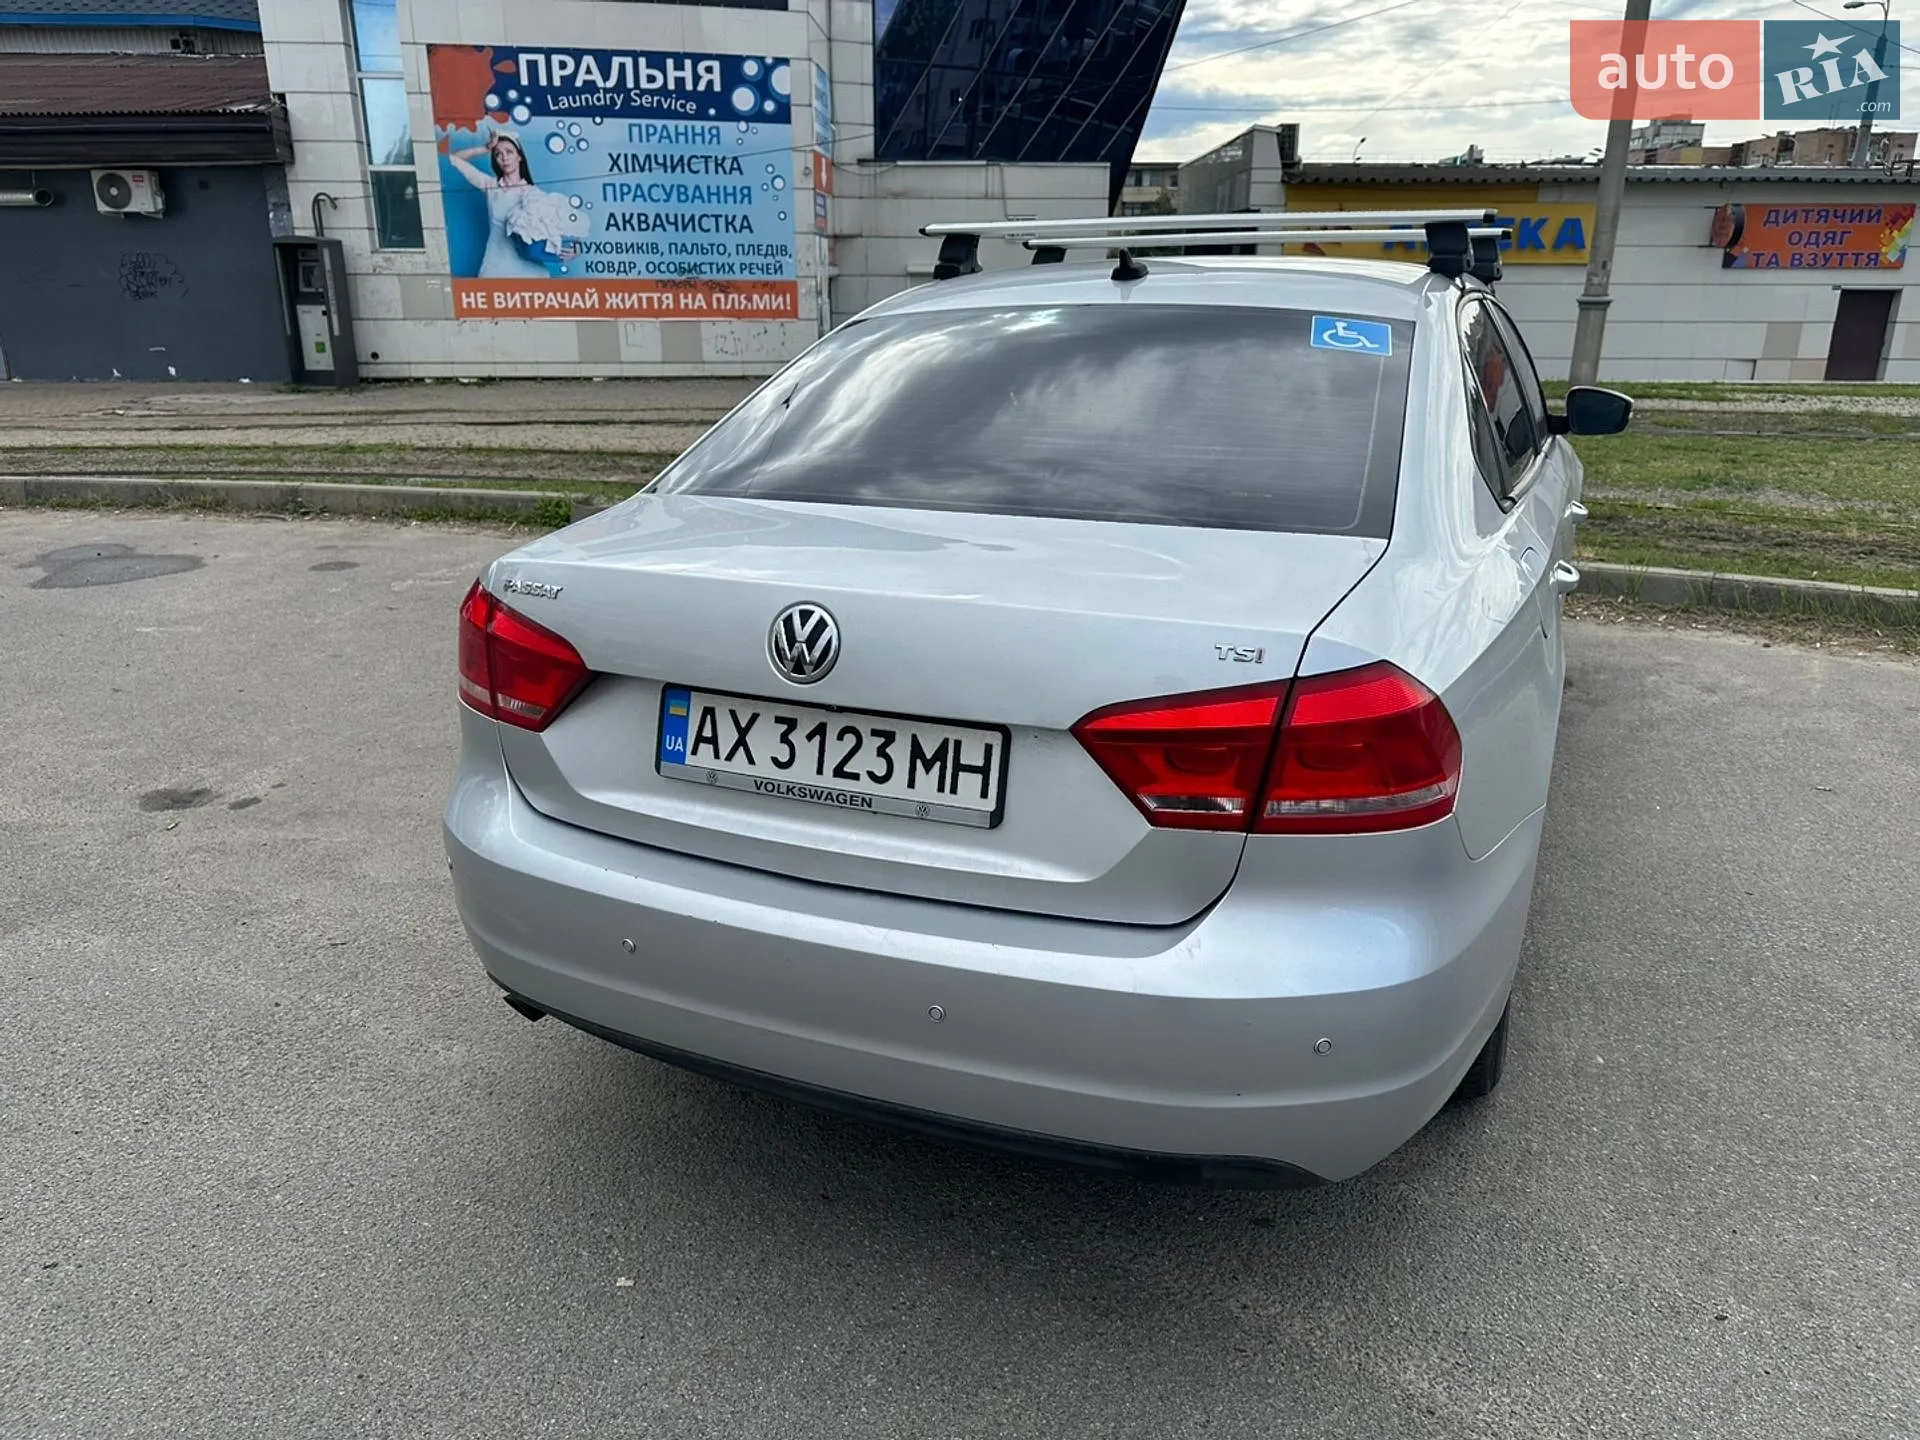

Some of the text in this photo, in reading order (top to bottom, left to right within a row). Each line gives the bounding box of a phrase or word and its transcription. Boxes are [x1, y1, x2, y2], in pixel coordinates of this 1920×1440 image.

[518, 53, 721, 92] ПРАЛЬНЯ
[547, 89, 697, 114] Laundry Service
[628, 123, 721, 145] ПРАННЯ
[608, 152, 744, 175] ХІМЧИСТКА
[602, 182, 752, 204] ПРАСУВАННЯ
[605, 212, 754, 234] АКВАЧИСТКА
[1763, 206, 1883, 227] ДИТЯЧИЙ
[573, 240, 792, 259] ПУХОВИКІВ, ПАЛЬТО, ПЛЕДІВ,
[1788, 231, 1852, 248] ОДЯГ
[585, 260, 783, 276] КОВДР, ОСОБИСТИХ РЕЧЕЙ
[1752, 252, 1880, 268] ТА ВЗУТТЯ
[461, 291, 488, 309] НЕ
[493, 287, 600, 309] ВИТРАЧАЙ
[605, 291, 674, 310] ЖИТТЯ
[680, 293, 706, 310] НА
[503, 579, 563, 600] PASSAT
[1214, 643, 1264, 664] TSI
[665, 735, 684, 752] UA
[770, 715, 896, 785] 3123
[753, 779, 872, 809] VOLKSWAGEN
